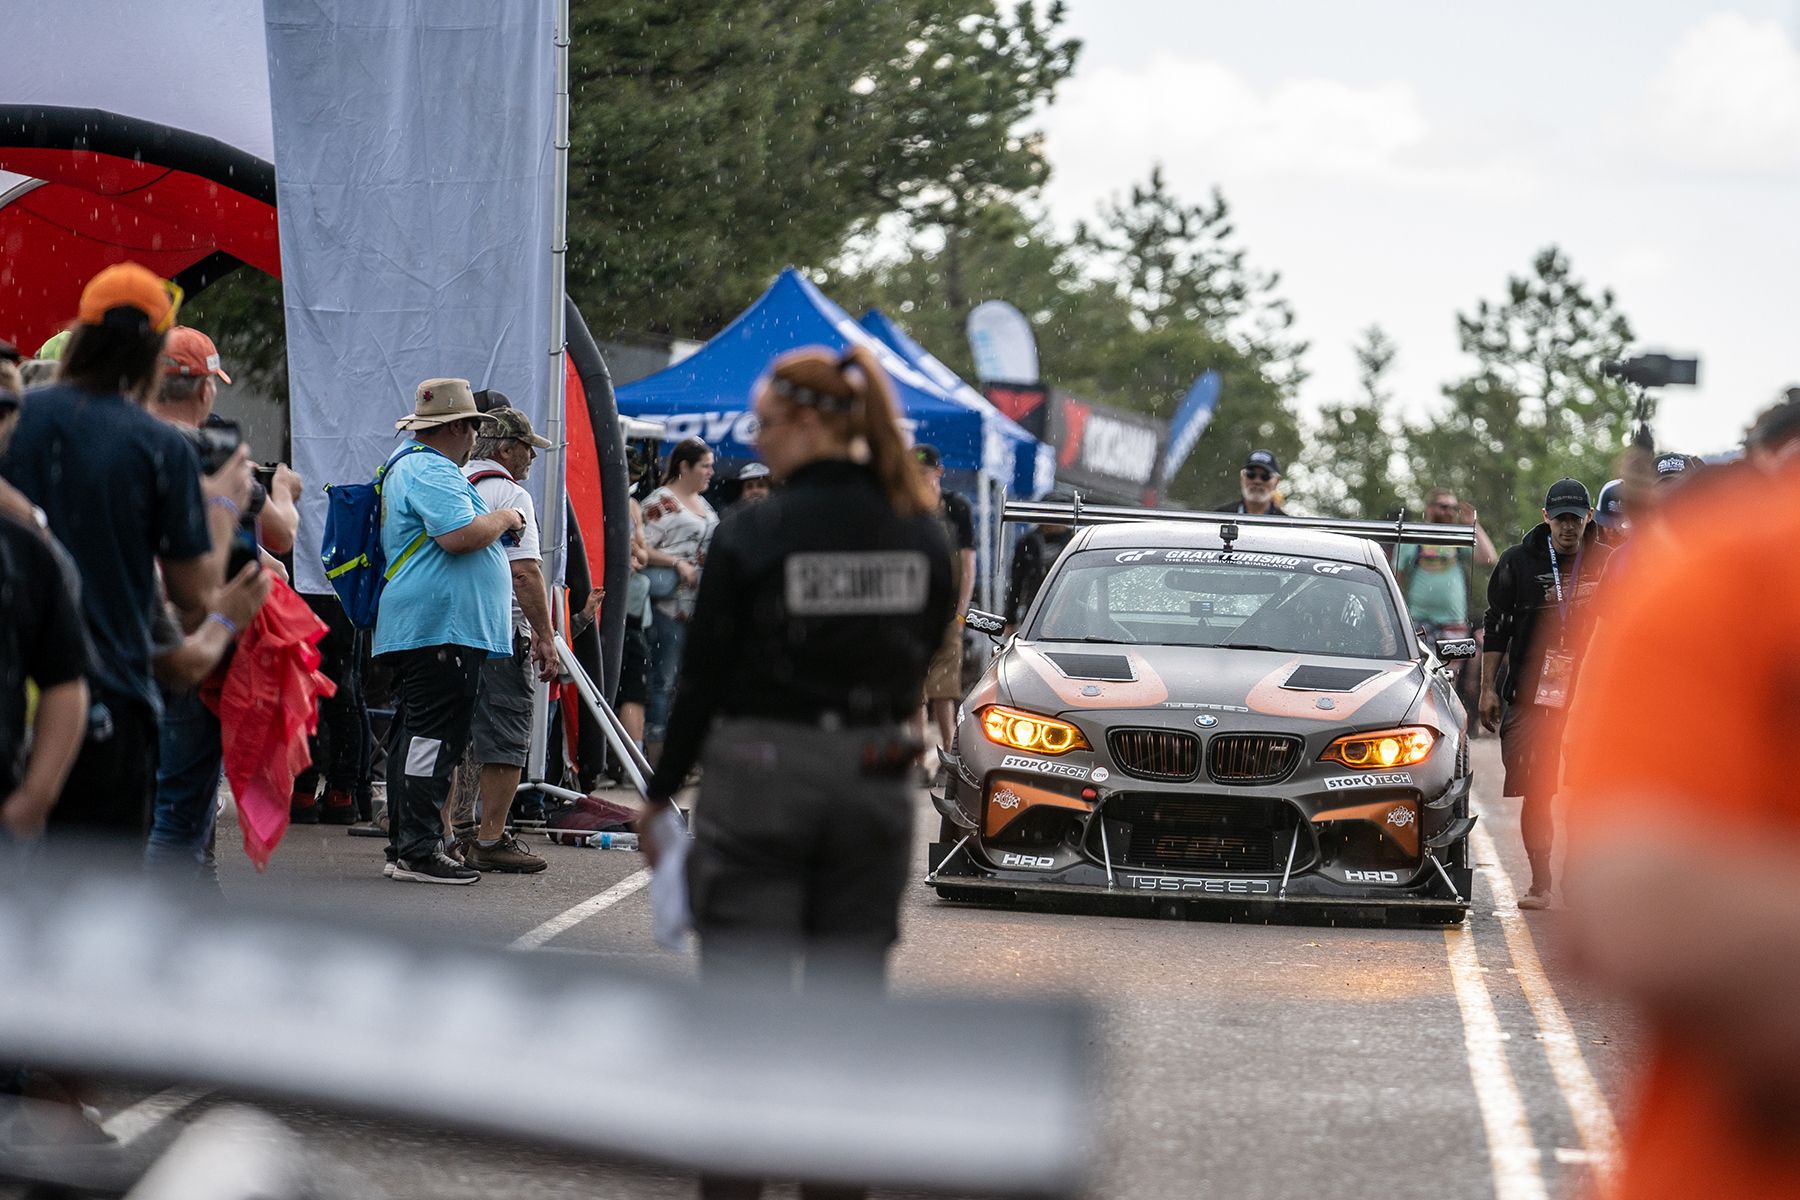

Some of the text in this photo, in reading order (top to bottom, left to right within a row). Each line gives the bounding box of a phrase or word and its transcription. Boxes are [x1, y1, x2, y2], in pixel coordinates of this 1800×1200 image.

[1165, 550, 1301, 567] GRAN TURISMO
[1244, 561, 1295, 570] SIMULATOR
[1002, 854, 1055, 867] HRD
[1344, 869, 1398, 882] HRD
[1127, 875, 1270, 893] TYSPEED
